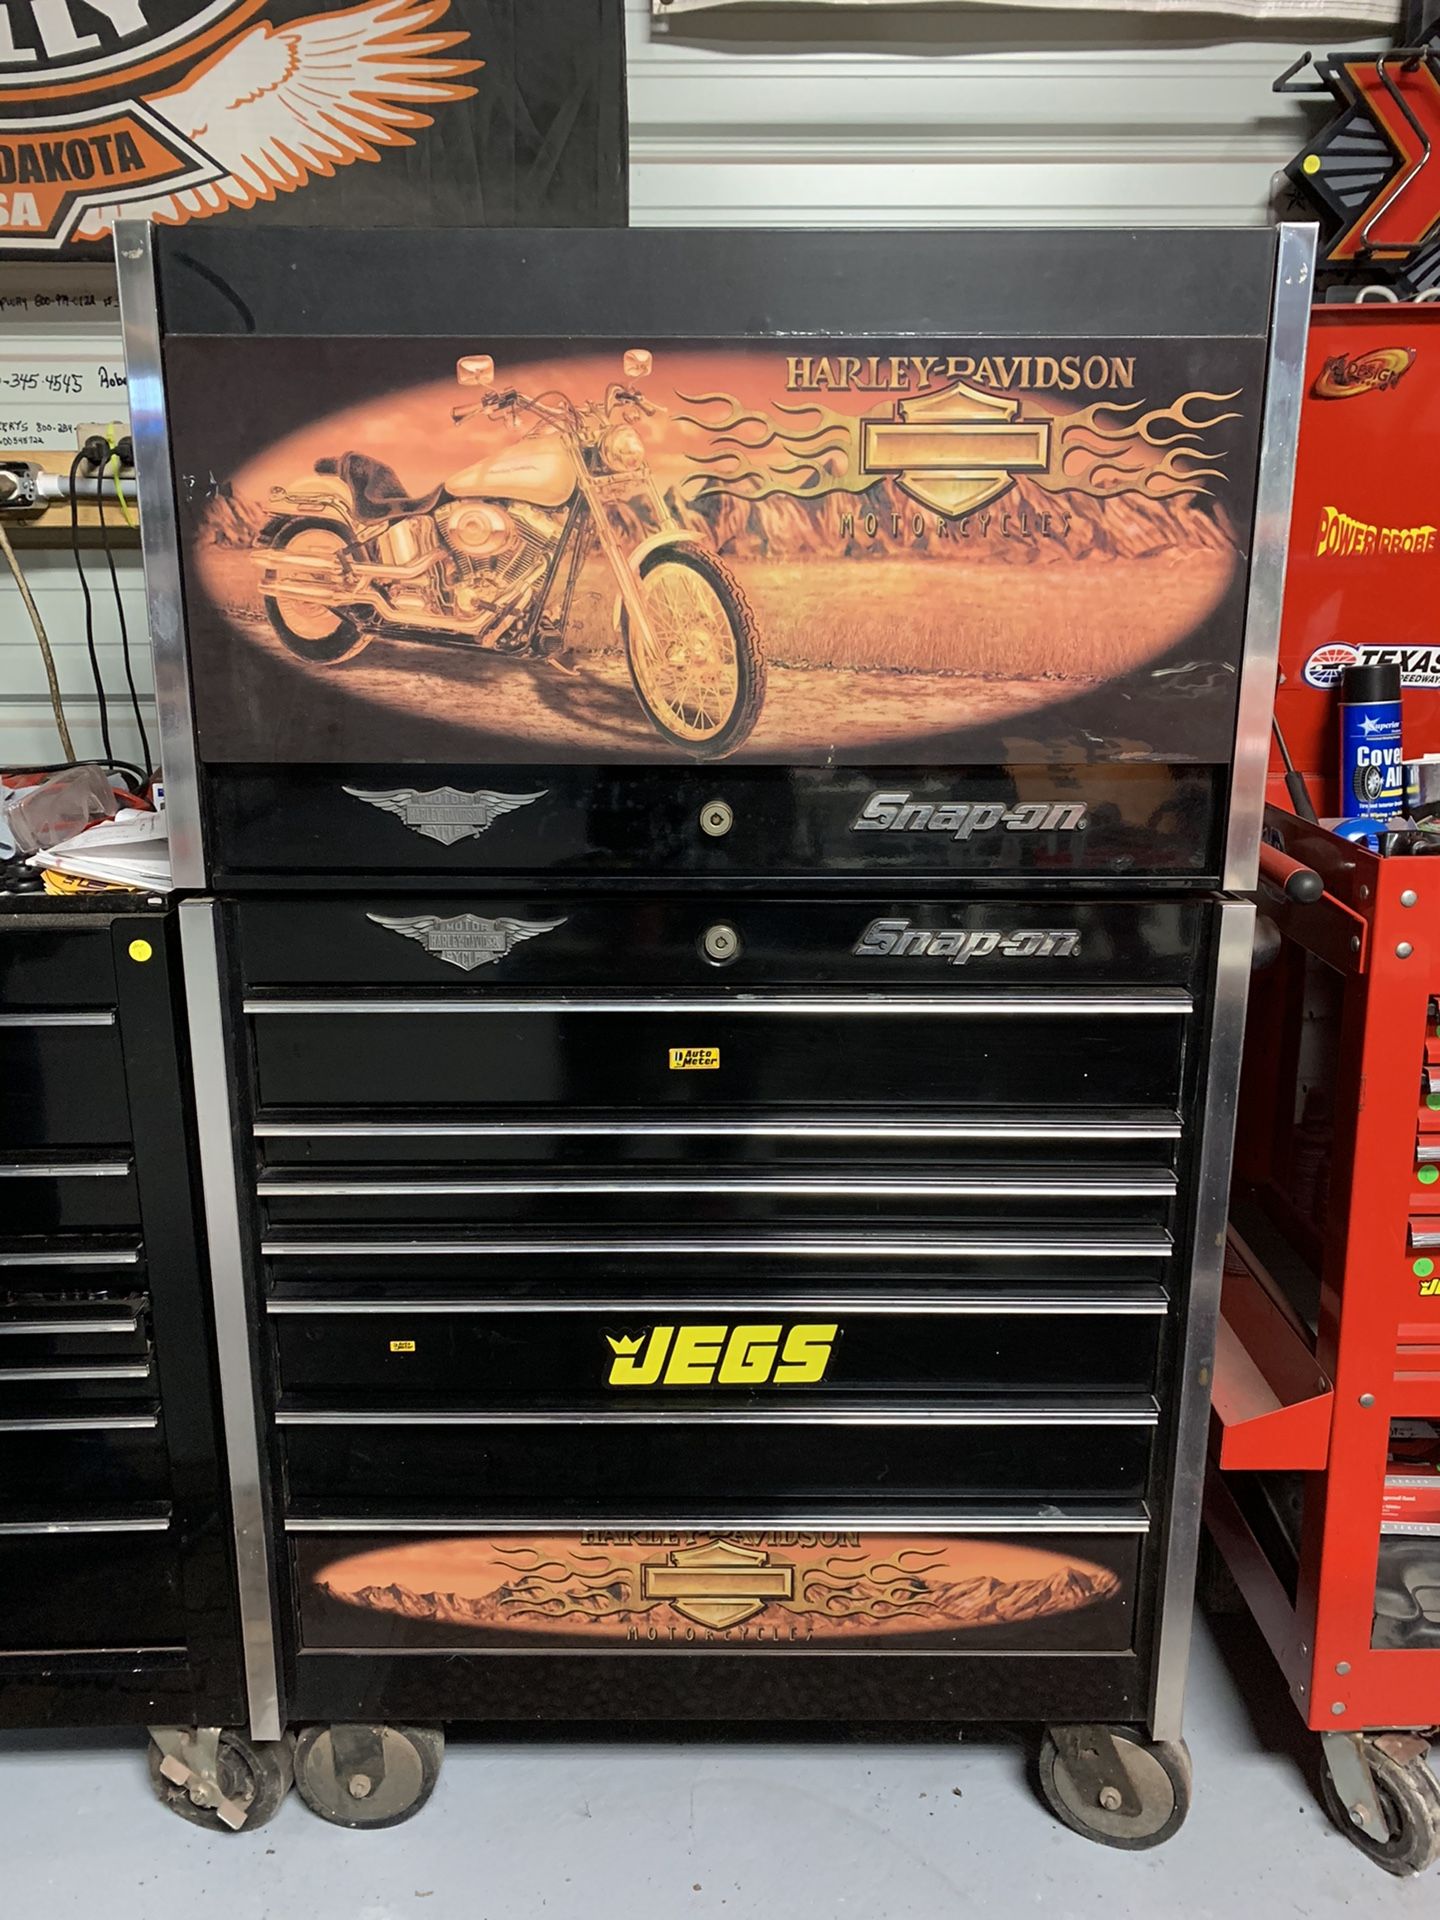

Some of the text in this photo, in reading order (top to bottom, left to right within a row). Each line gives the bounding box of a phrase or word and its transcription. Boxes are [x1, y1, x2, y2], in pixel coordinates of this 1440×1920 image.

[0, 130, 145, 185] DAKOTA
[786, 354, 1137, 392] HARLEY-DAVIDSON
[839, 511, 1074, 539] MOTORCYCLES
[1315, 506, 1438, 556] POWER PROBE
[1399, 674, 1440, 684] EEDWAY
[851, 790, 1083, 840] Snap-on
[851, 916, 1078, 965] Snap-on
[682, 1057, 717, 1067] Meter
[685, 1049, 712, 1058] Auto
[608, 1323, 839, 1385] JEGS
[626, 1626, 815, 1642] MOTORCYCLES
